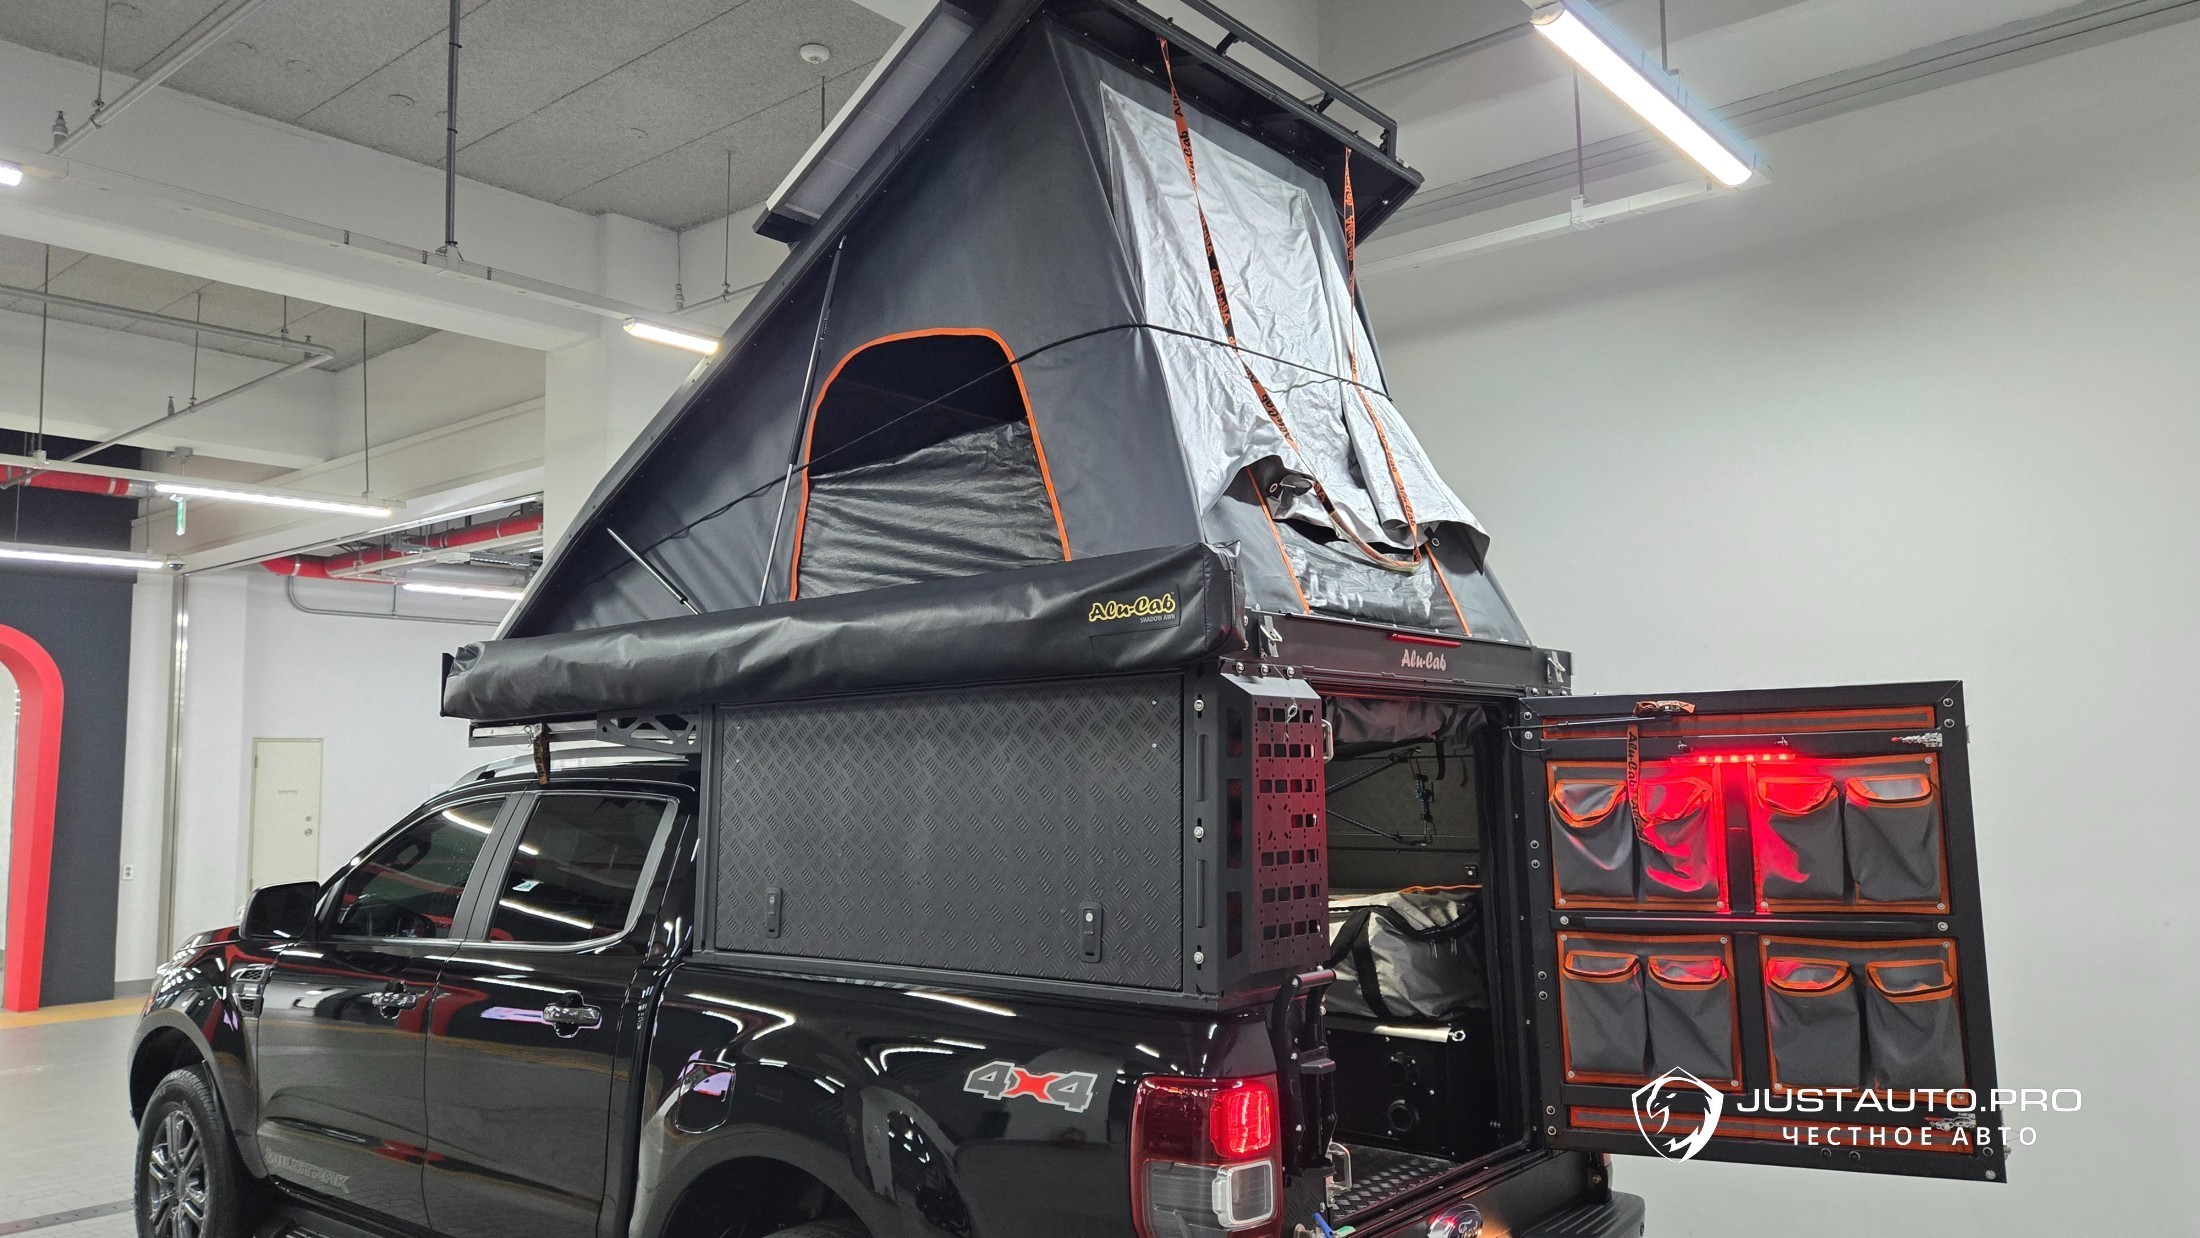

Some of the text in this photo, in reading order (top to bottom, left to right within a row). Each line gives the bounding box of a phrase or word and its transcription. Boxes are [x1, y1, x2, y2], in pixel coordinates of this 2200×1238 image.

[1262, 394, 1293, 442] Alu-Cab
[1089, 593, 1176, 622] Alu-Cab
[1140, 614, 1163, 624] SHADOW
[1401, 648, 1447, 672] Alu-Cab
[1628, 731, 1638, 787] Alu-Cab
